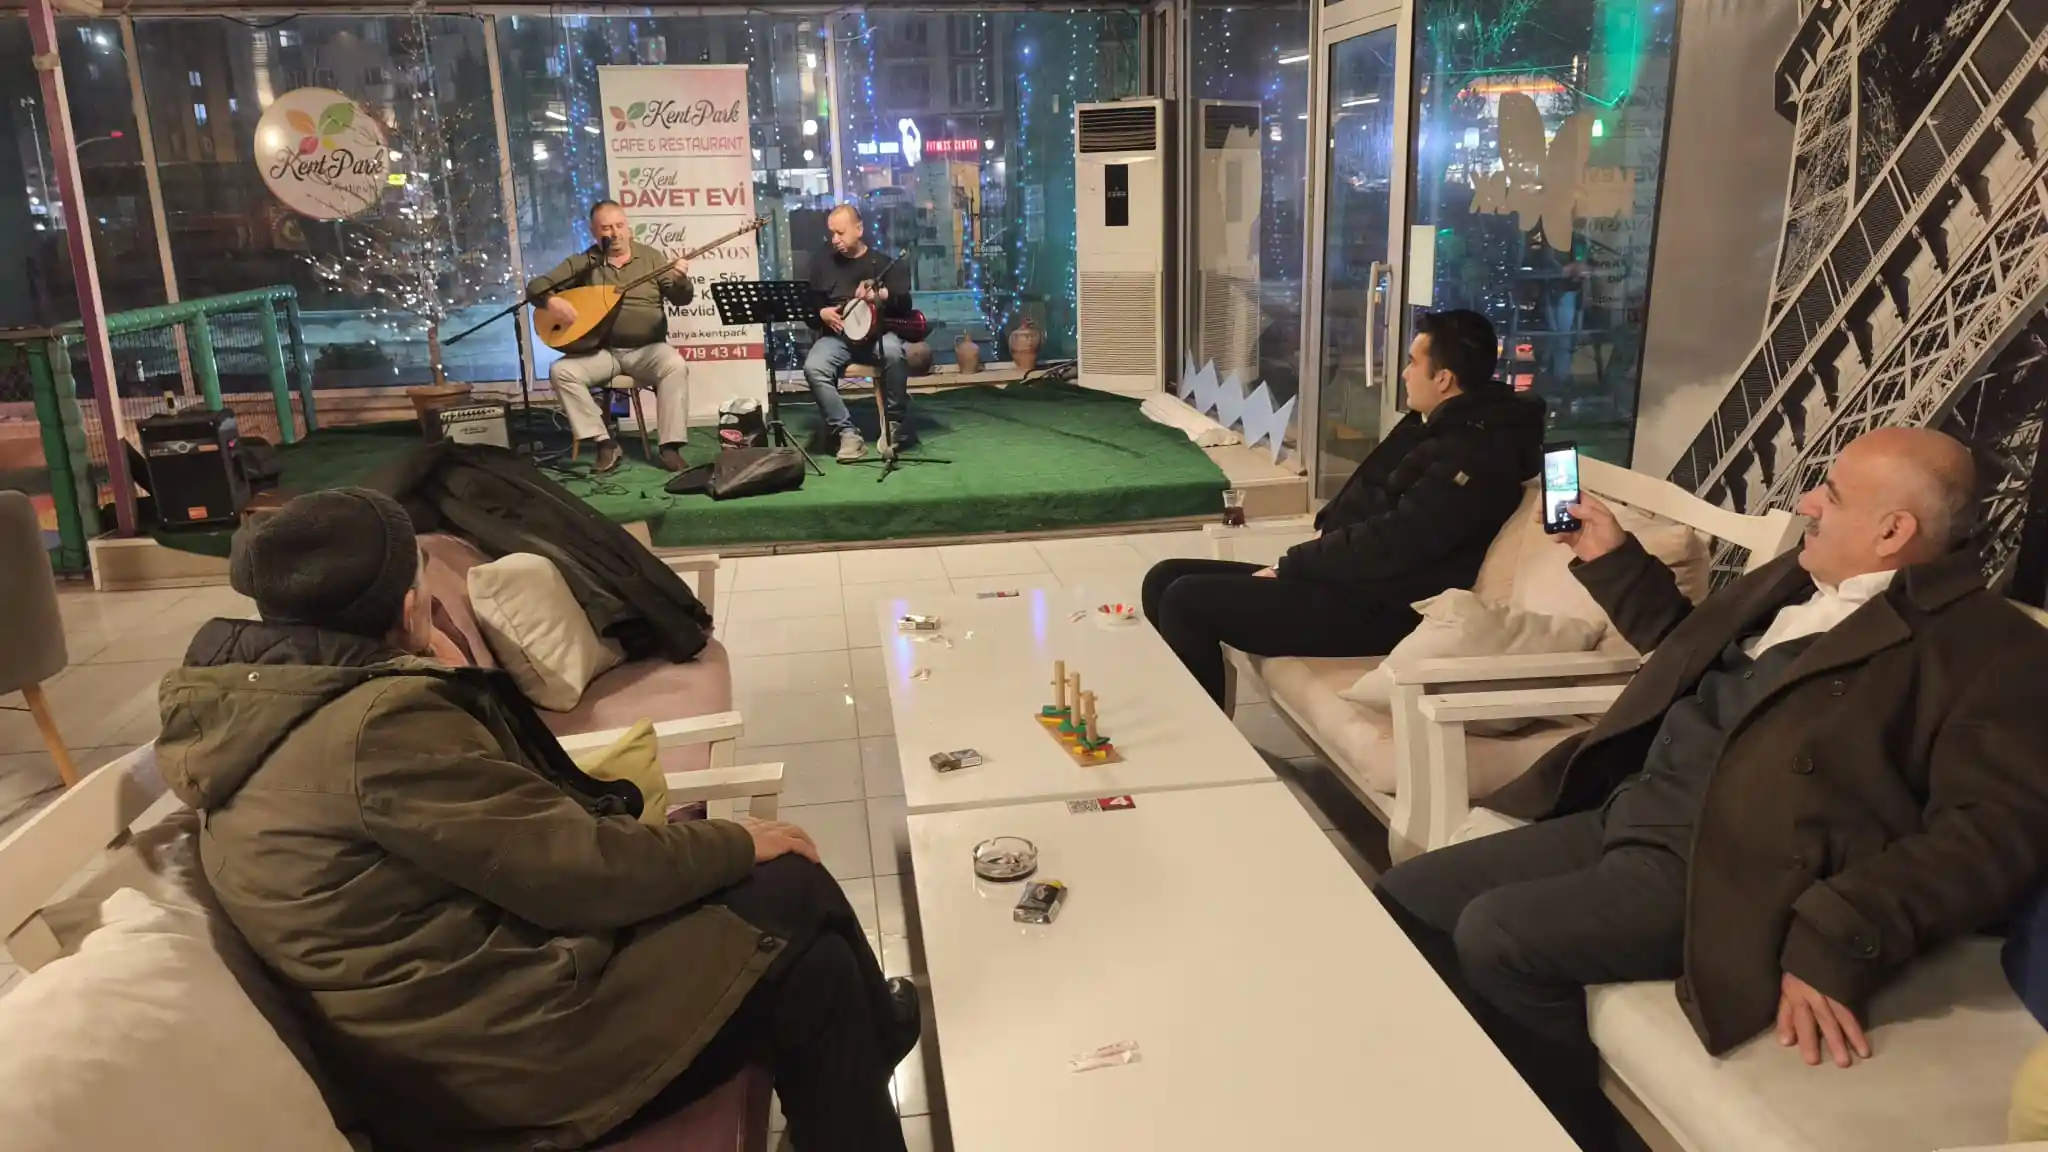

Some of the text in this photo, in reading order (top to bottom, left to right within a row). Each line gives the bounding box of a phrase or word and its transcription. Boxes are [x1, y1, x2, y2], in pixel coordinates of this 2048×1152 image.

[642, 100, 740, 129] Kent Park
[611, 138, 645, 152] CAFE
[660, 136, 744, 151] RESTAURANT
[270, 146, 384, 181] Kent Park
[638, 167, 679, 190] Kent
[619, 181, 746, 208] DAVET EVİ
[644, 223, 687, 247] Kent
[719, 271, 747, 283] Söz
[668, 304, 716, 317] Mevlid
[683, 347, 707, 359] 719
[710, 346, 729, 358] 43
[732, 345, 748, 357] 41
